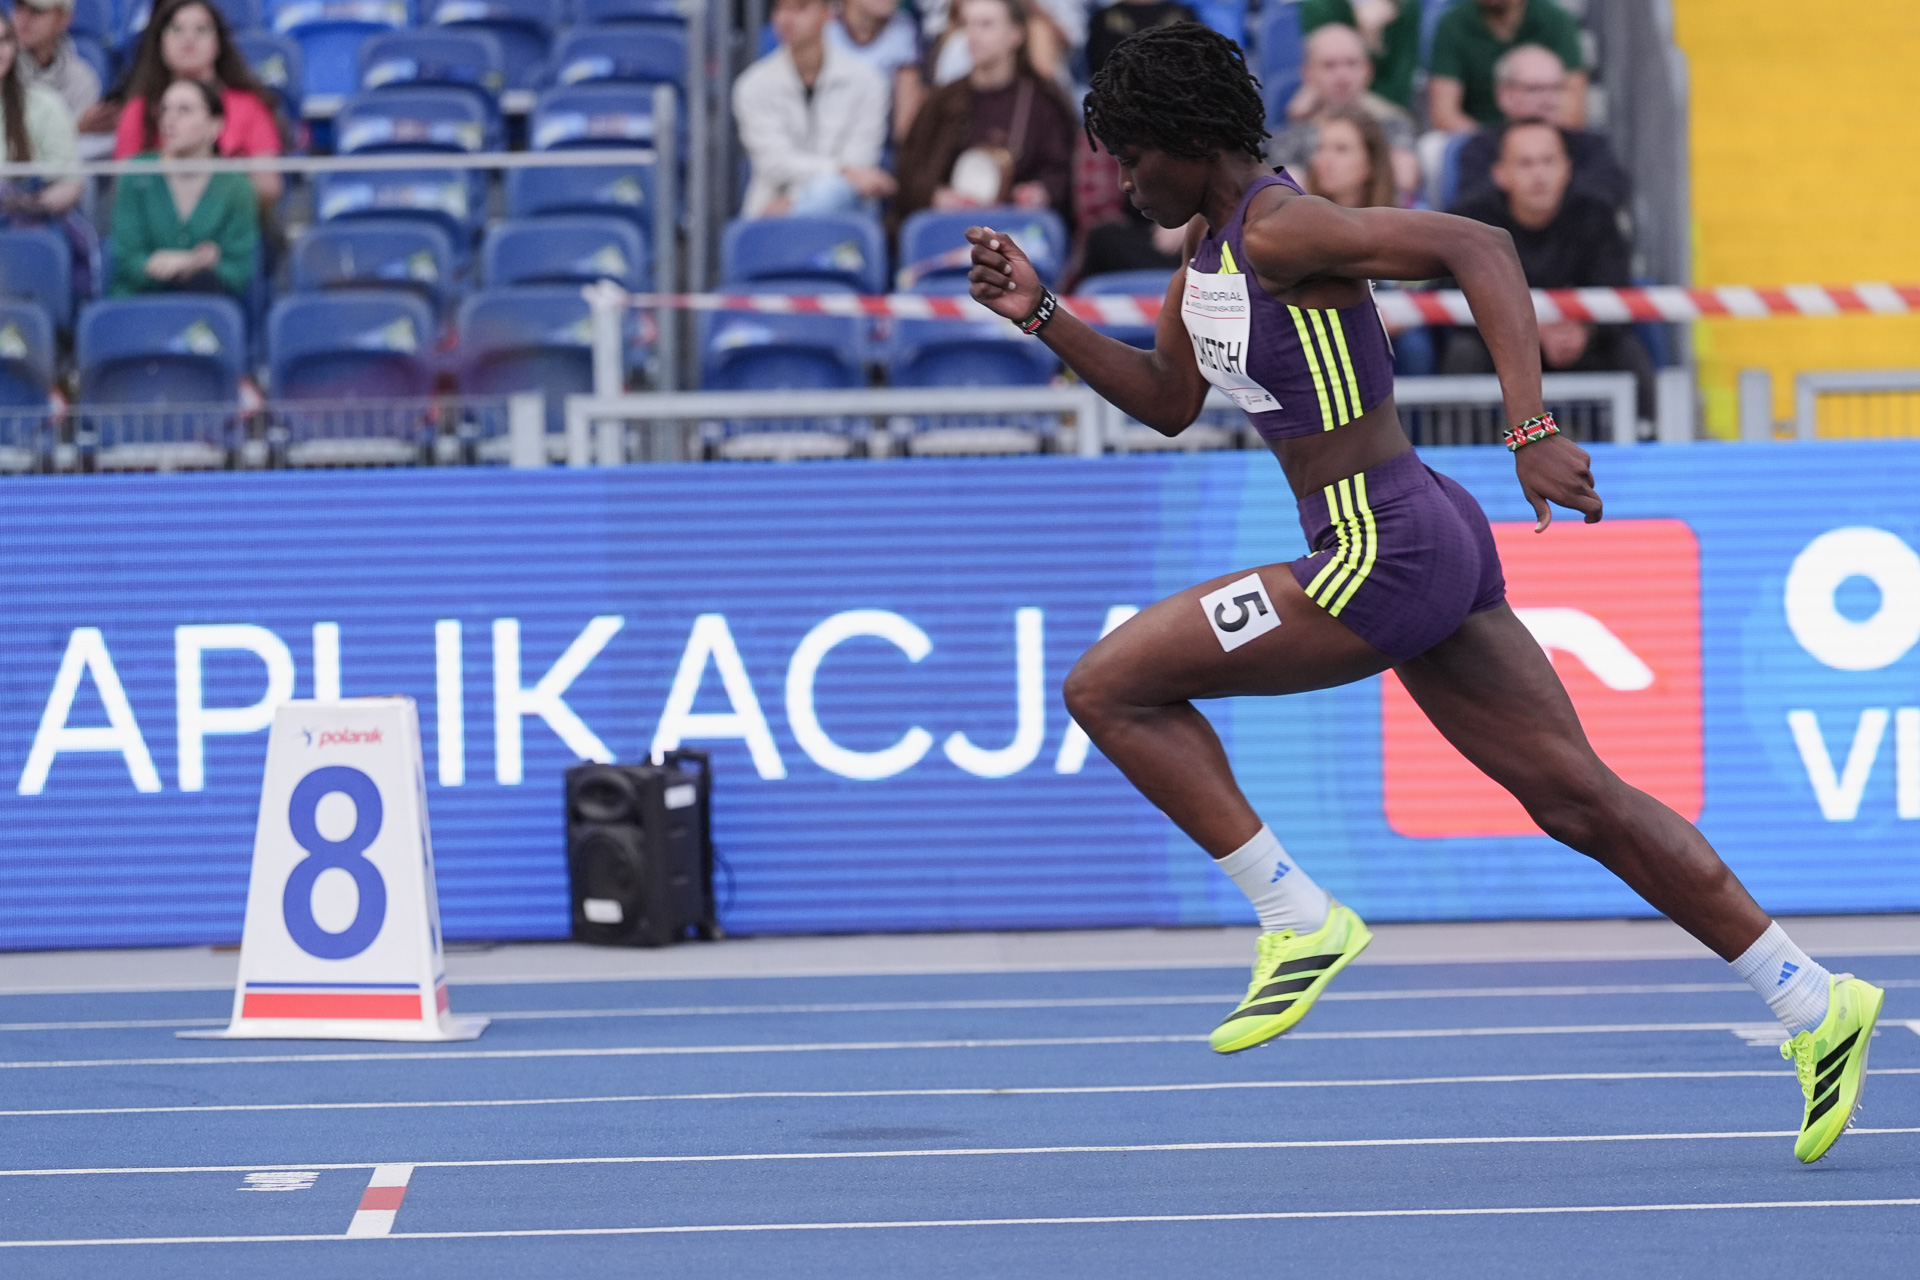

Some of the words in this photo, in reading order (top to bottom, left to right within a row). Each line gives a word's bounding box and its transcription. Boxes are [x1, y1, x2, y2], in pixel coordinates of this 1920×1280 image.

[1214, 591, 1268, 632] 5
[318, 726, 383, 749] polanik
[283, 766, 387, 960] 8
